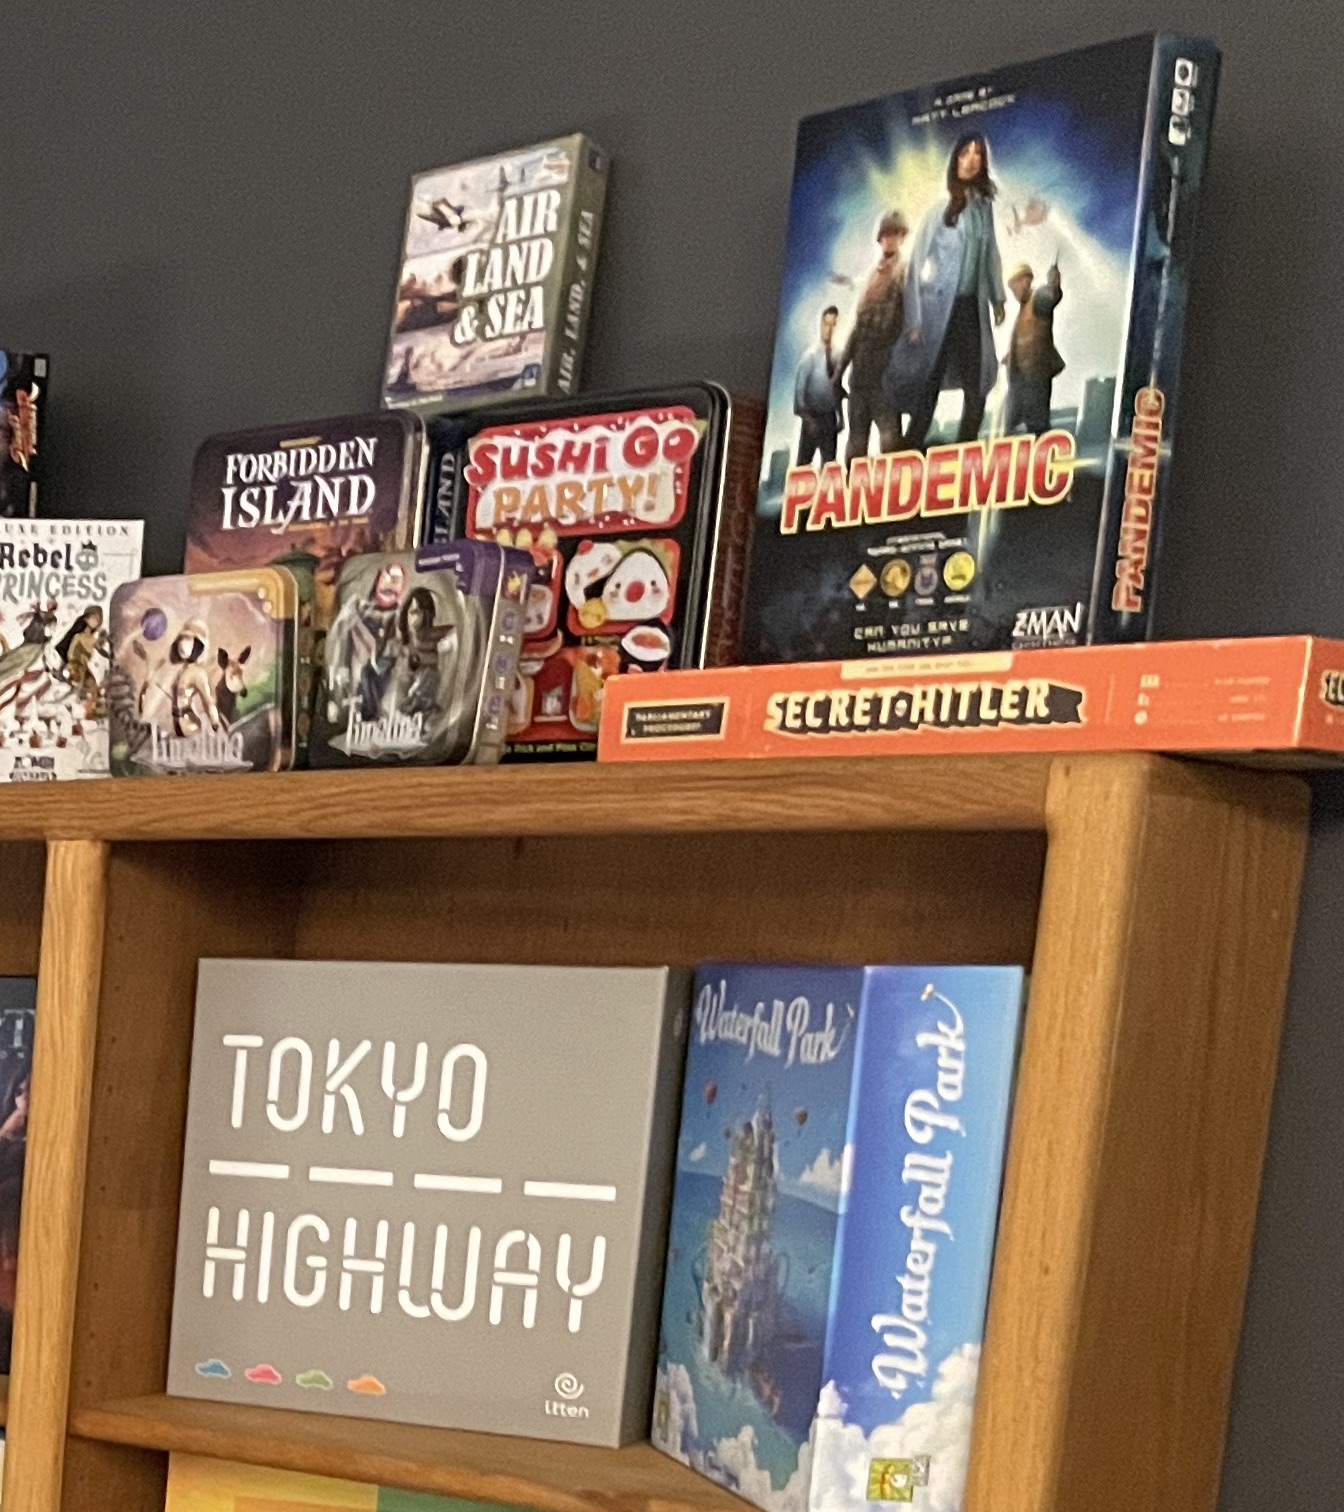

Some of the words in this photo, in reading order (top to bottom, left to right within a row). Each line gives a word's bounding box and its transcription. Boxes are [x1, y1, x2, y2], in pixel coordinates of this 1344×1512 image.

[496, 188, 561, 245] AIR
[577, 210, 595, 247] SEA
[462, 236, 555, 299] LAND
[453, 305, 479, 344] &
[483, 285, 545, 339] SEA
[225, 435, 379, 486] FORBIDDEN
[622, 425, 697, 469] GO
[220, 473, 376, 535] ISLAND
[492, 472, 661, 525] PARTY!
[780, 428, 1078, 535] PANDEMIC
[1112, 384, 1167, 615] PANDEMIC
[0, 541, 74, 571] Rebel
[50, 524, 130, 537] EDITION
[891, 622, 921, 638] YOU
[764, 688, 895, 733] SECRET
[908, 678, 1051, 724] HITLER
[696, 978, 784, 1064] Waterfall
[785, 996, 843, 1070] Park
[221, 1033, 490, 1144] TOKYO
[904, 1003, 968, 1145] Park
[201, 1205, 607, 1334] HIGHWAY
[870, 1148, 956, 1401] Waterfall
